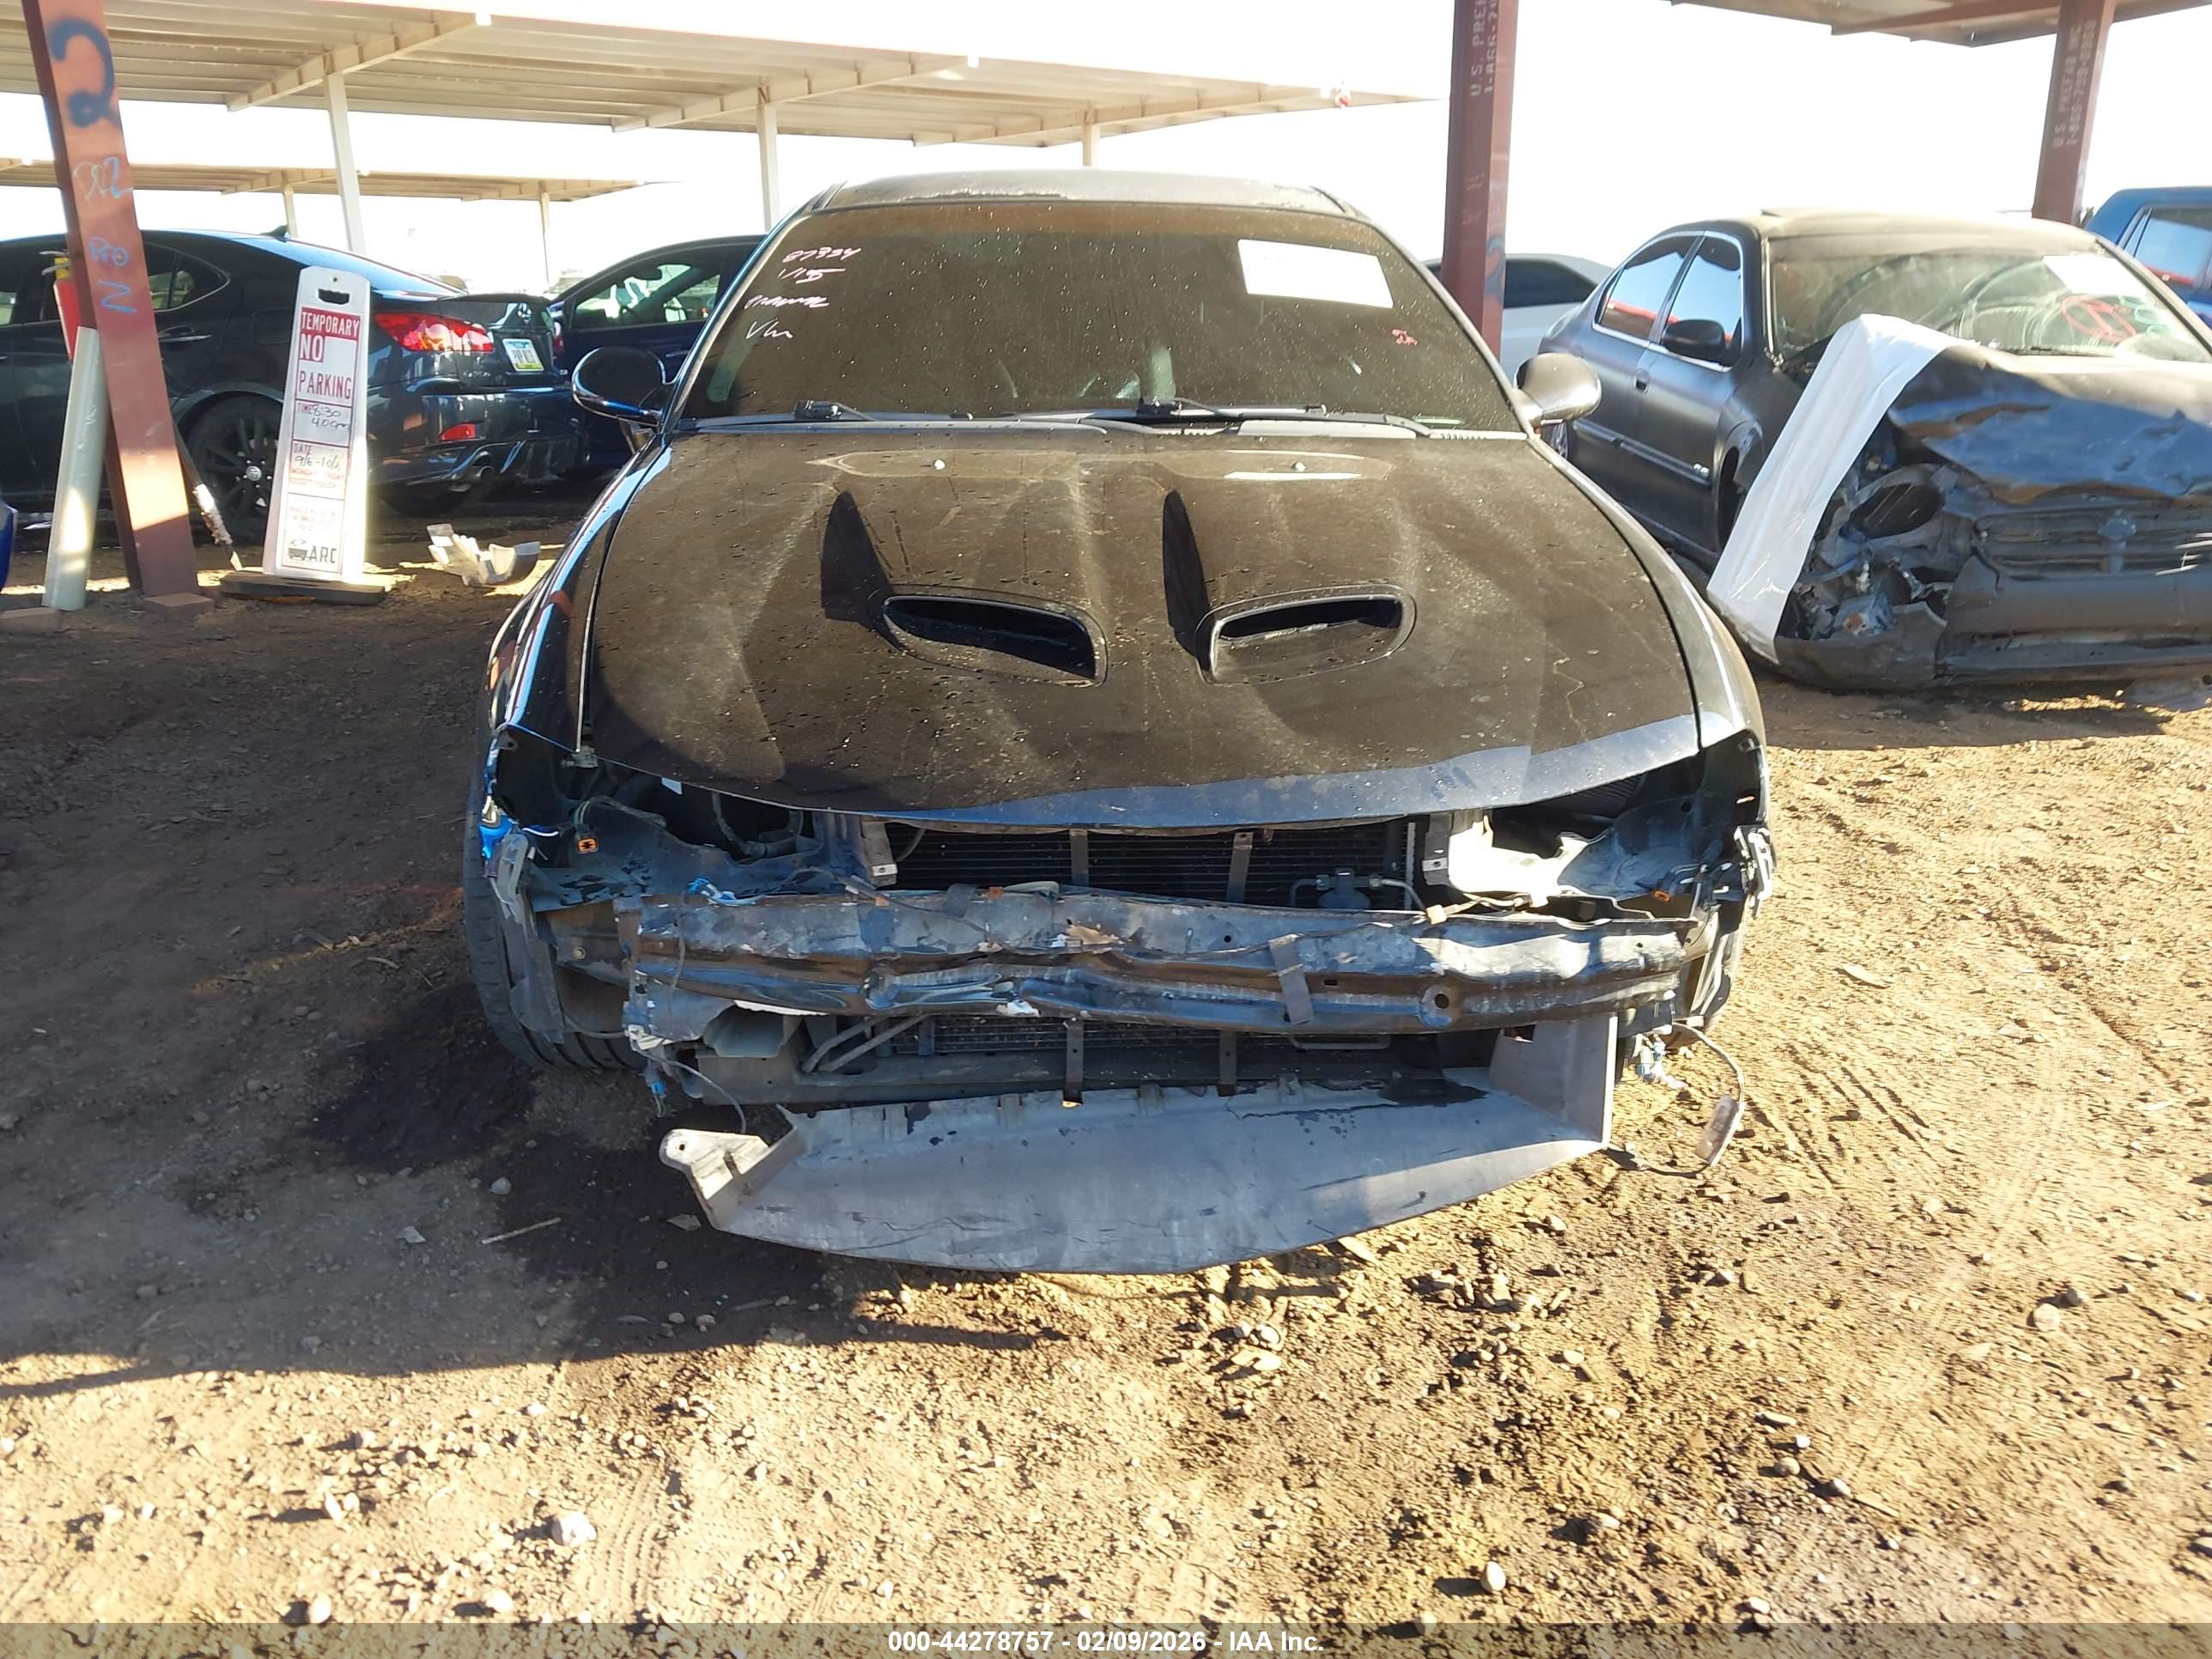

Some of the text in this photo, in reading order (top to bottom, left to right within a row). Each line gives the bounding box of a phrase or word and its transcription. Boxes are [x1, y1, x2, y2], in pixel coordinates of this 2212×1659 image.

[302, 312, 359, 337] TEMPORARY
[300, 333, 324, 362] NO
[298, 370, 352, 400] PARKING
[309, 545, 337, 563] ARC
